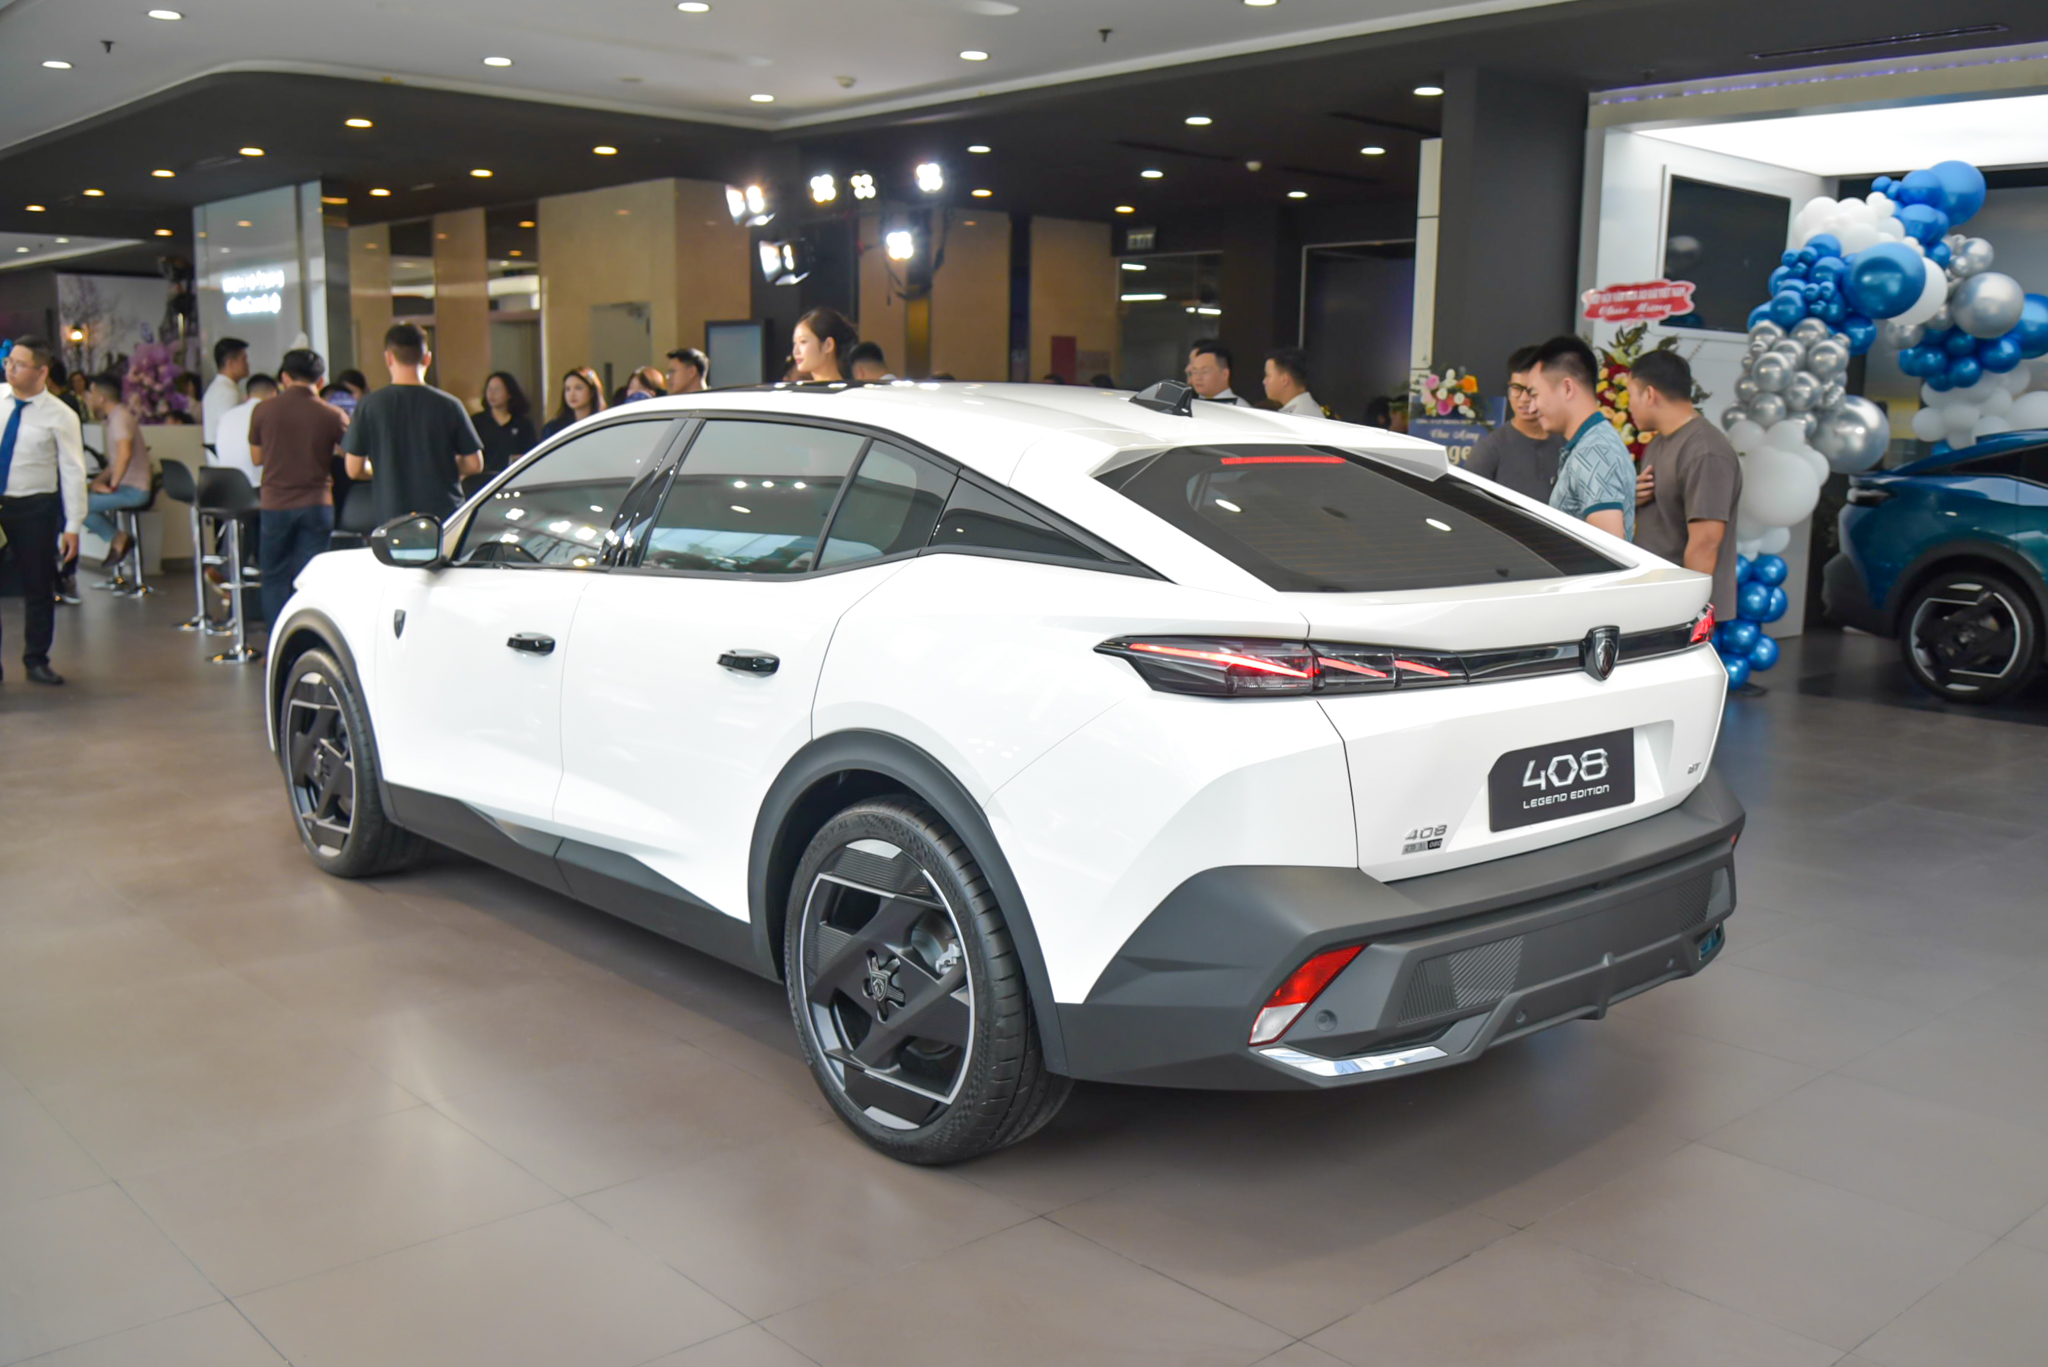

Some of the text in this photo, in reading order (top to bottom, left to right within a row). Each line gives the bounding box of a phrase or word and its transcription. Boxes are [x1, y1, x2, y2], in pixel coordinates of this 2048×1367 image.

[1522, 748, 1610, 791] 408
[1523, 784, 1610, 809] LEGEND EDITION
[1404, 824, 1448, 841] 408
